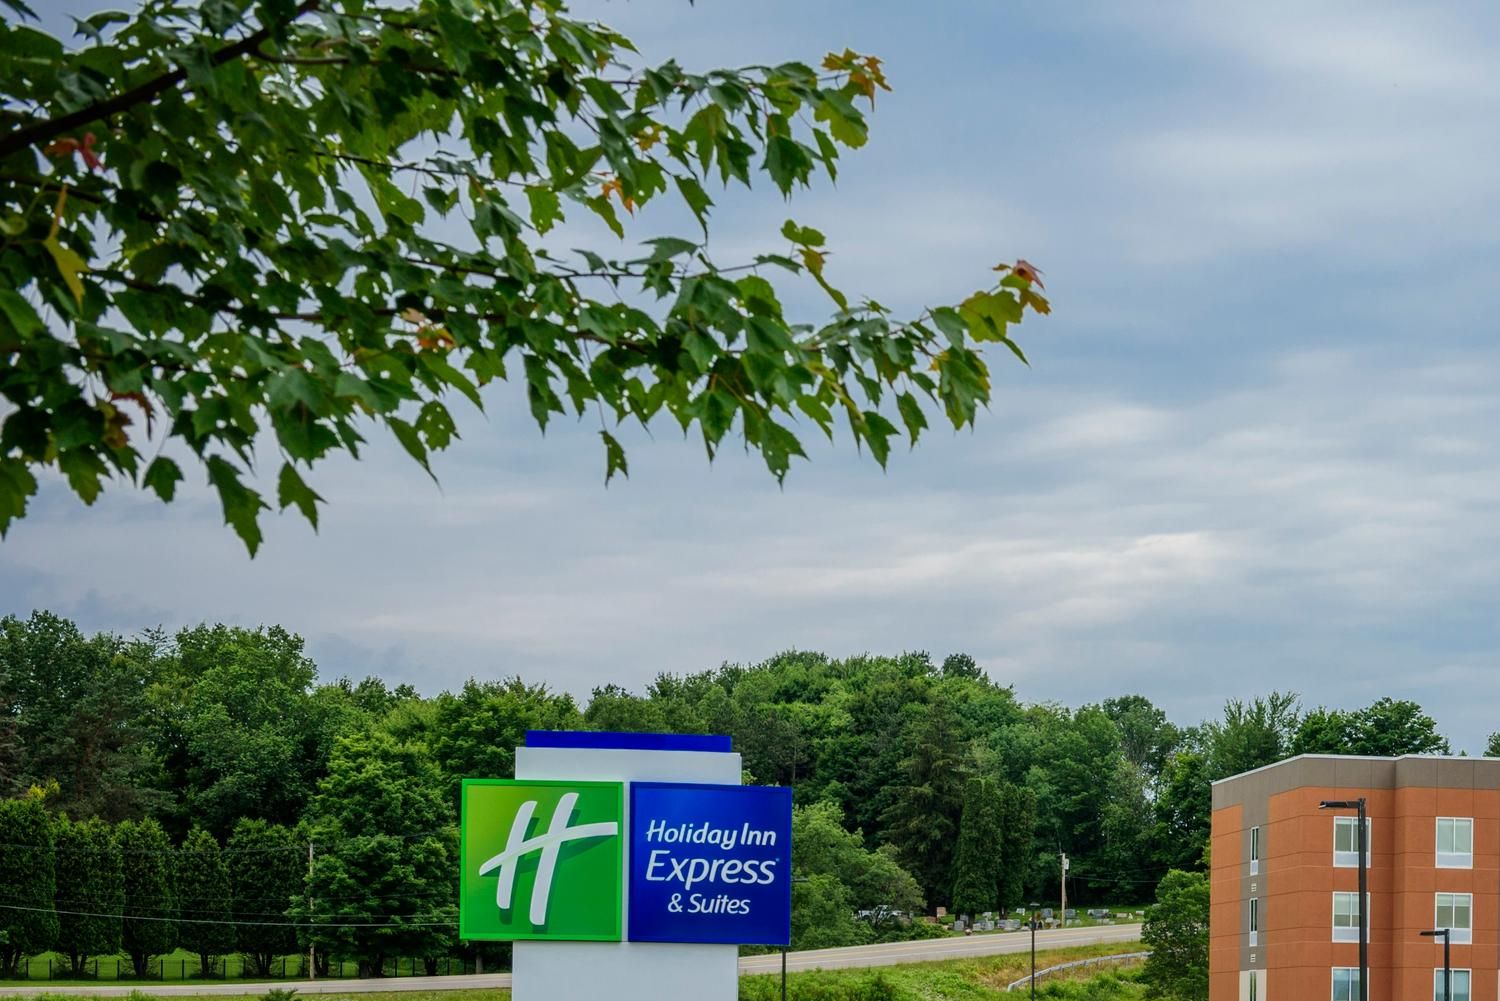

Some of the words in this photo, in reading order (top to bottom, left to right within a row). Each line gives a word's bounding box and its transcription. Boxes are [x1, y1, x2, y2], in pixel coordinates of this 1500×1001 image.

[646, 819, 738, 850] Holiday
[740, 822, 777, 846] Inn
[645, 849, 777, 891] Express
[667, 892, 683, 913] &
[687, 893, 751, 915] Suites
